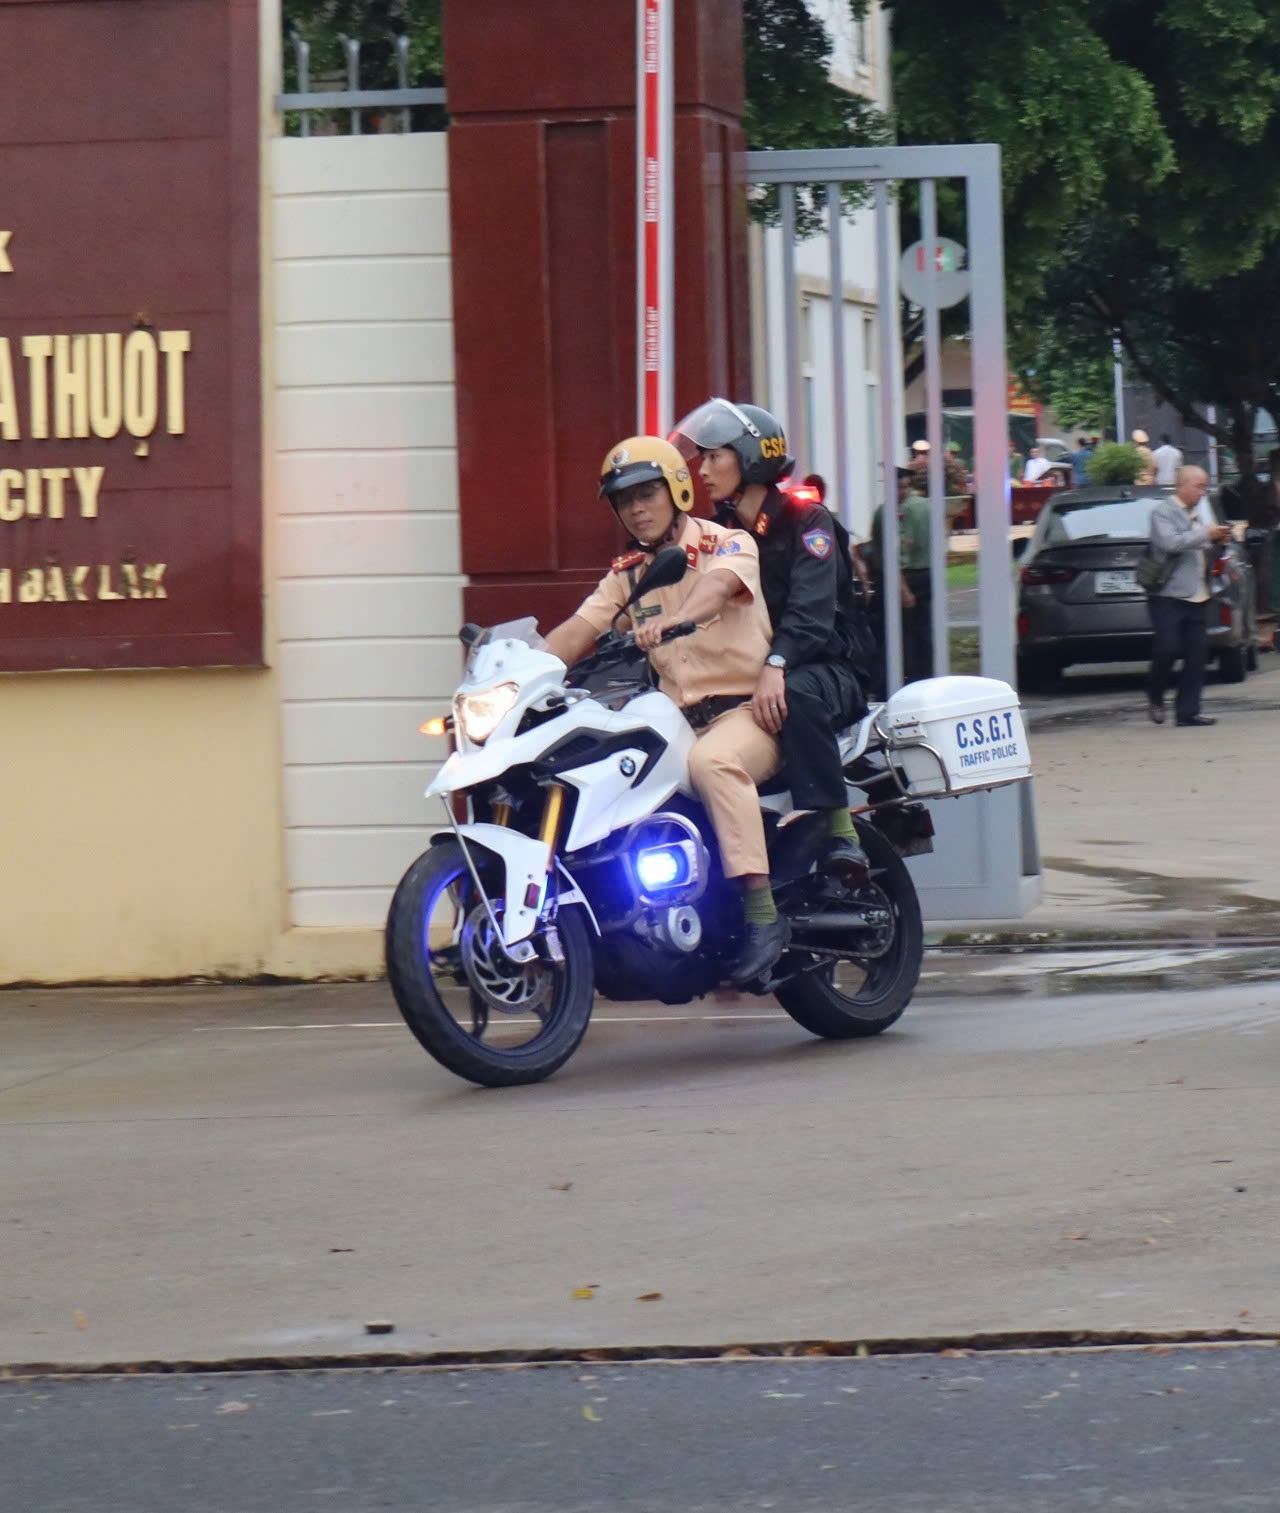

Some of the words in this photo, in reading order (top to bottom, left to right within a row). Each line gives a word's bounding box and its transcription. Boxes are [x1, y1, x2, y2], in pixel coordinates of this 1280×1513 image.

[0, 466, 105, 521] CITY
[956, 712, 1013, 749] C.S.G.T
[960, 750, 991, 768] TRAFFIC
[992, 743, 1018, 761] POLICE
